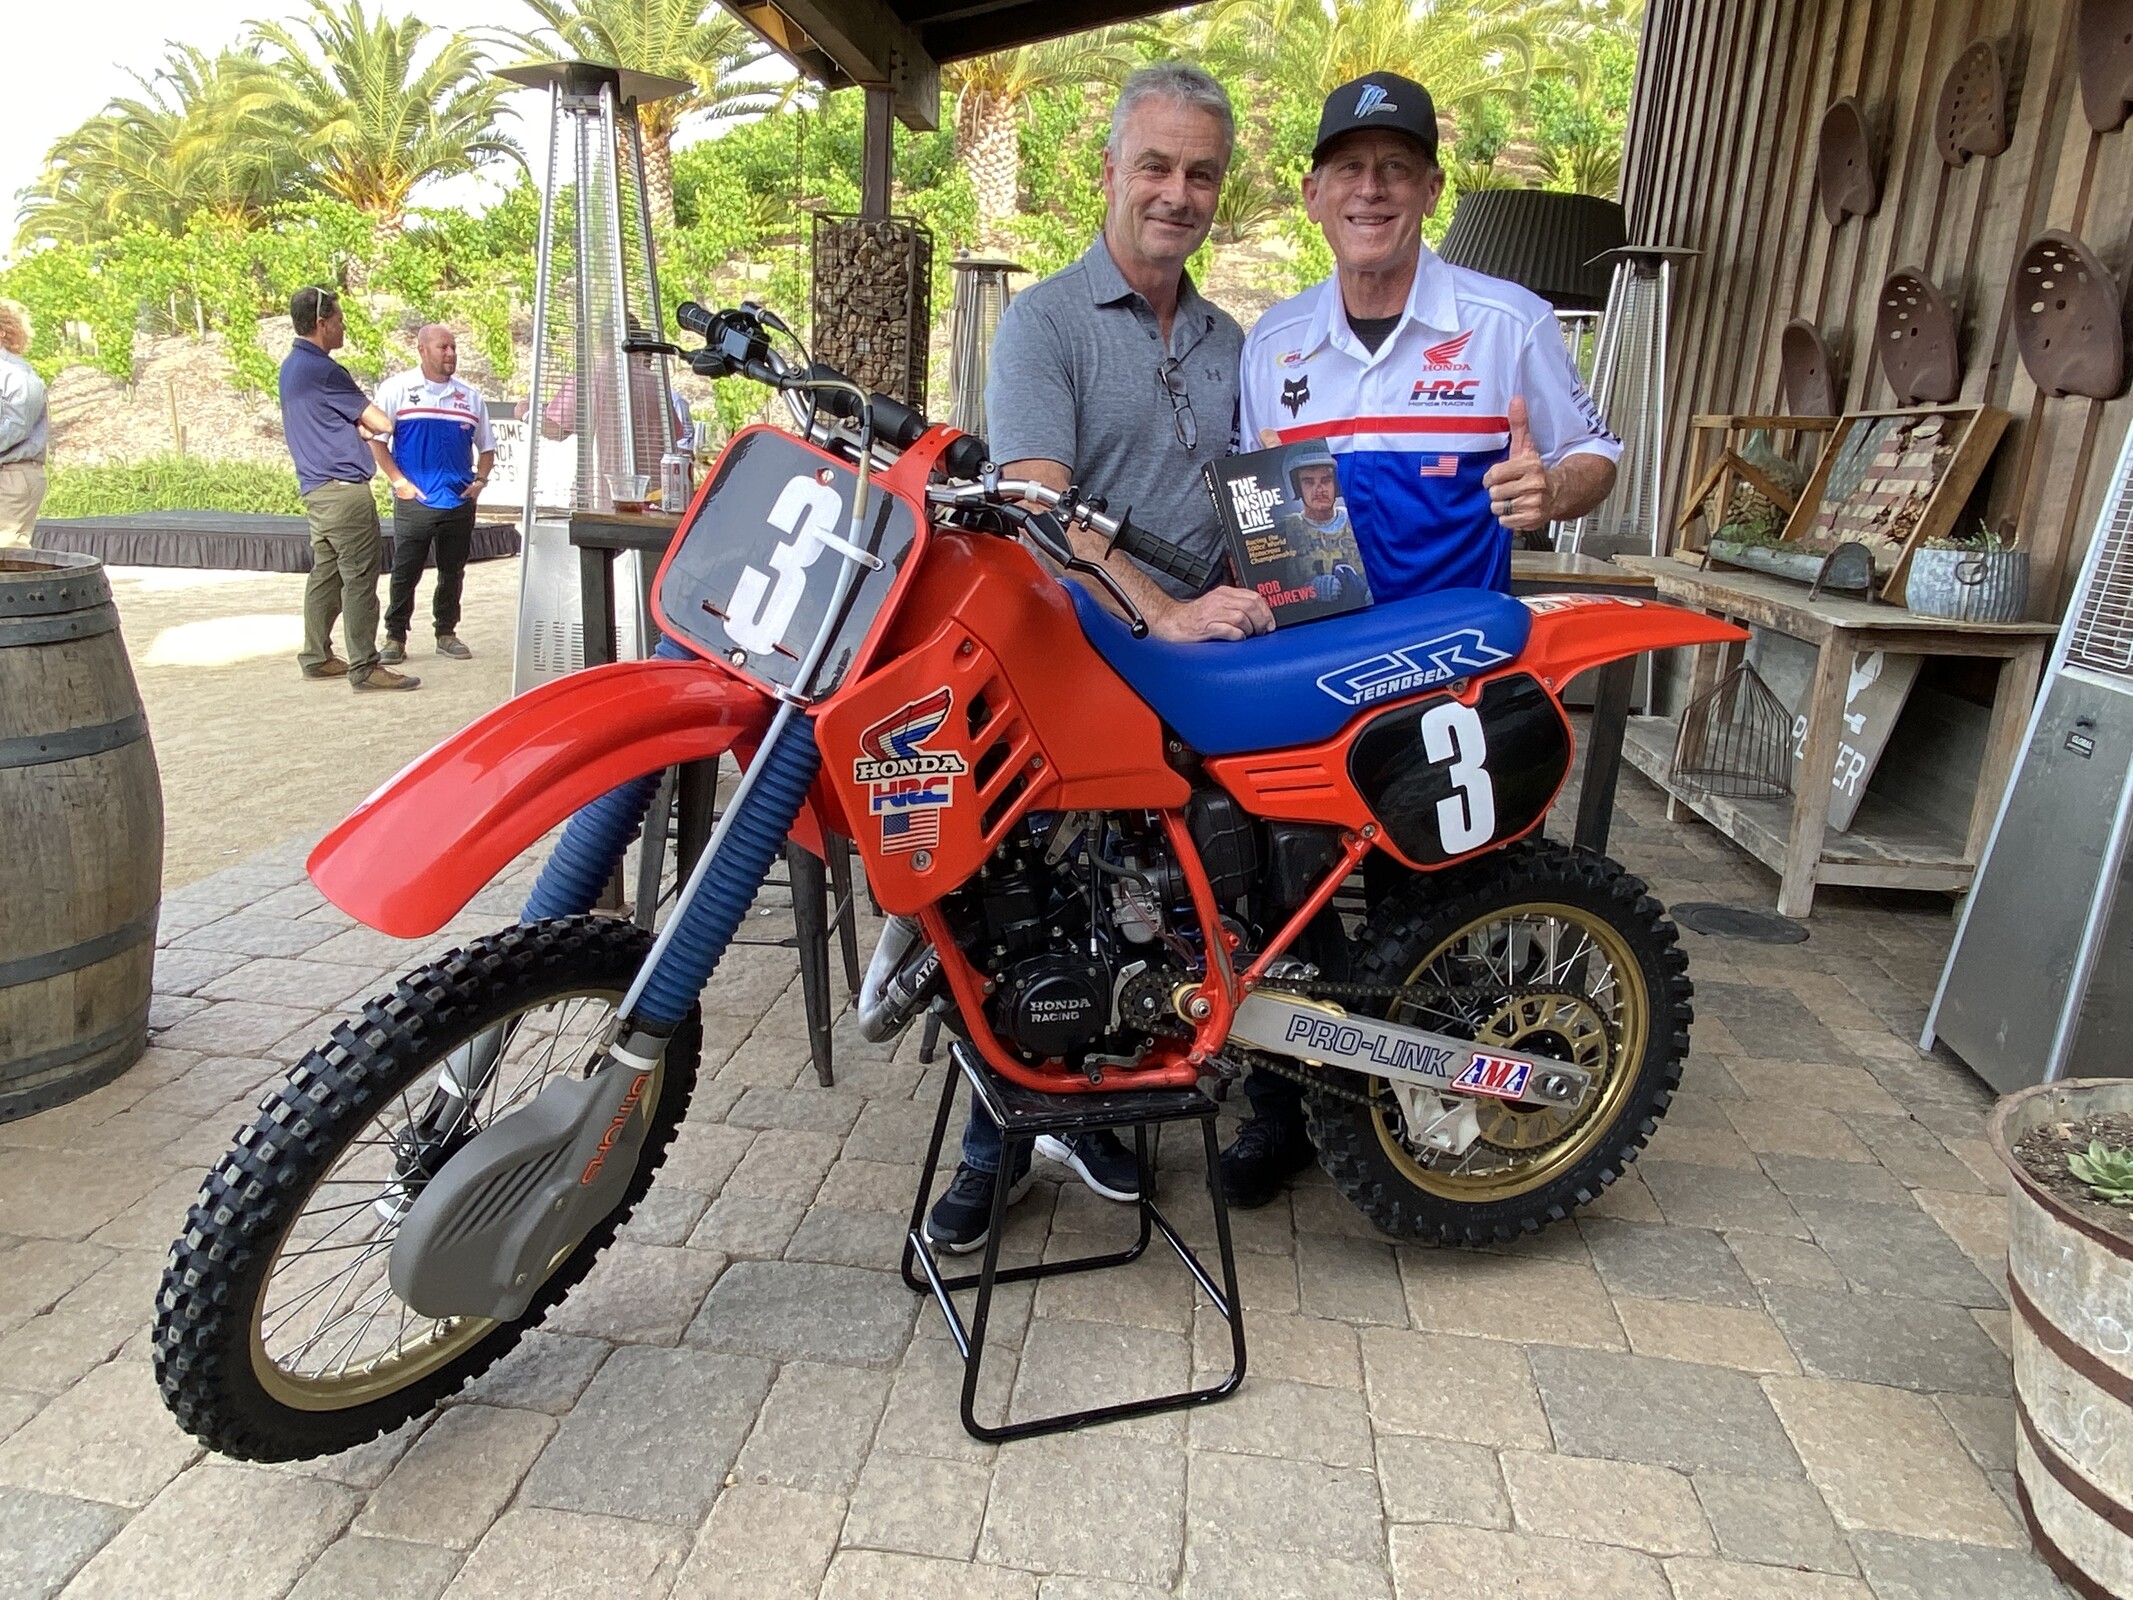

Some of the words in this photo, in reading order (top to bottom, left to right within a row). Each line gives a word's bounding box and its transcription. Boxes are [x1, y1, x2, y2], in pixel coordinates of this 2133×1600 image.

[1422, 363, 1472, 372] HONDA
[1410, 380, 1480, 401] HRC
[1227, 475, 1261, 498] THE
[1232, 487, 1285, 514] INSIDE
[1237, 507, 1274, 530] LINE
[722, 474, 843, 656] 3
[1257, 580, 1281, 597] ROB
[1266, 585, 1317, 608] NDREWS
[857, 755, 963, 780] HONDA
[1420, 701, 1496, 855] 3
[873, 776, 949, 811] HRC
[1029, 998, 1091, 1012] HONDA
[1031, 1011, 1080, 1023] RACING
[1285, 1014, 1456, 1078] PRO-LINK
[1458, 1057, 1530, 1092] AMA
